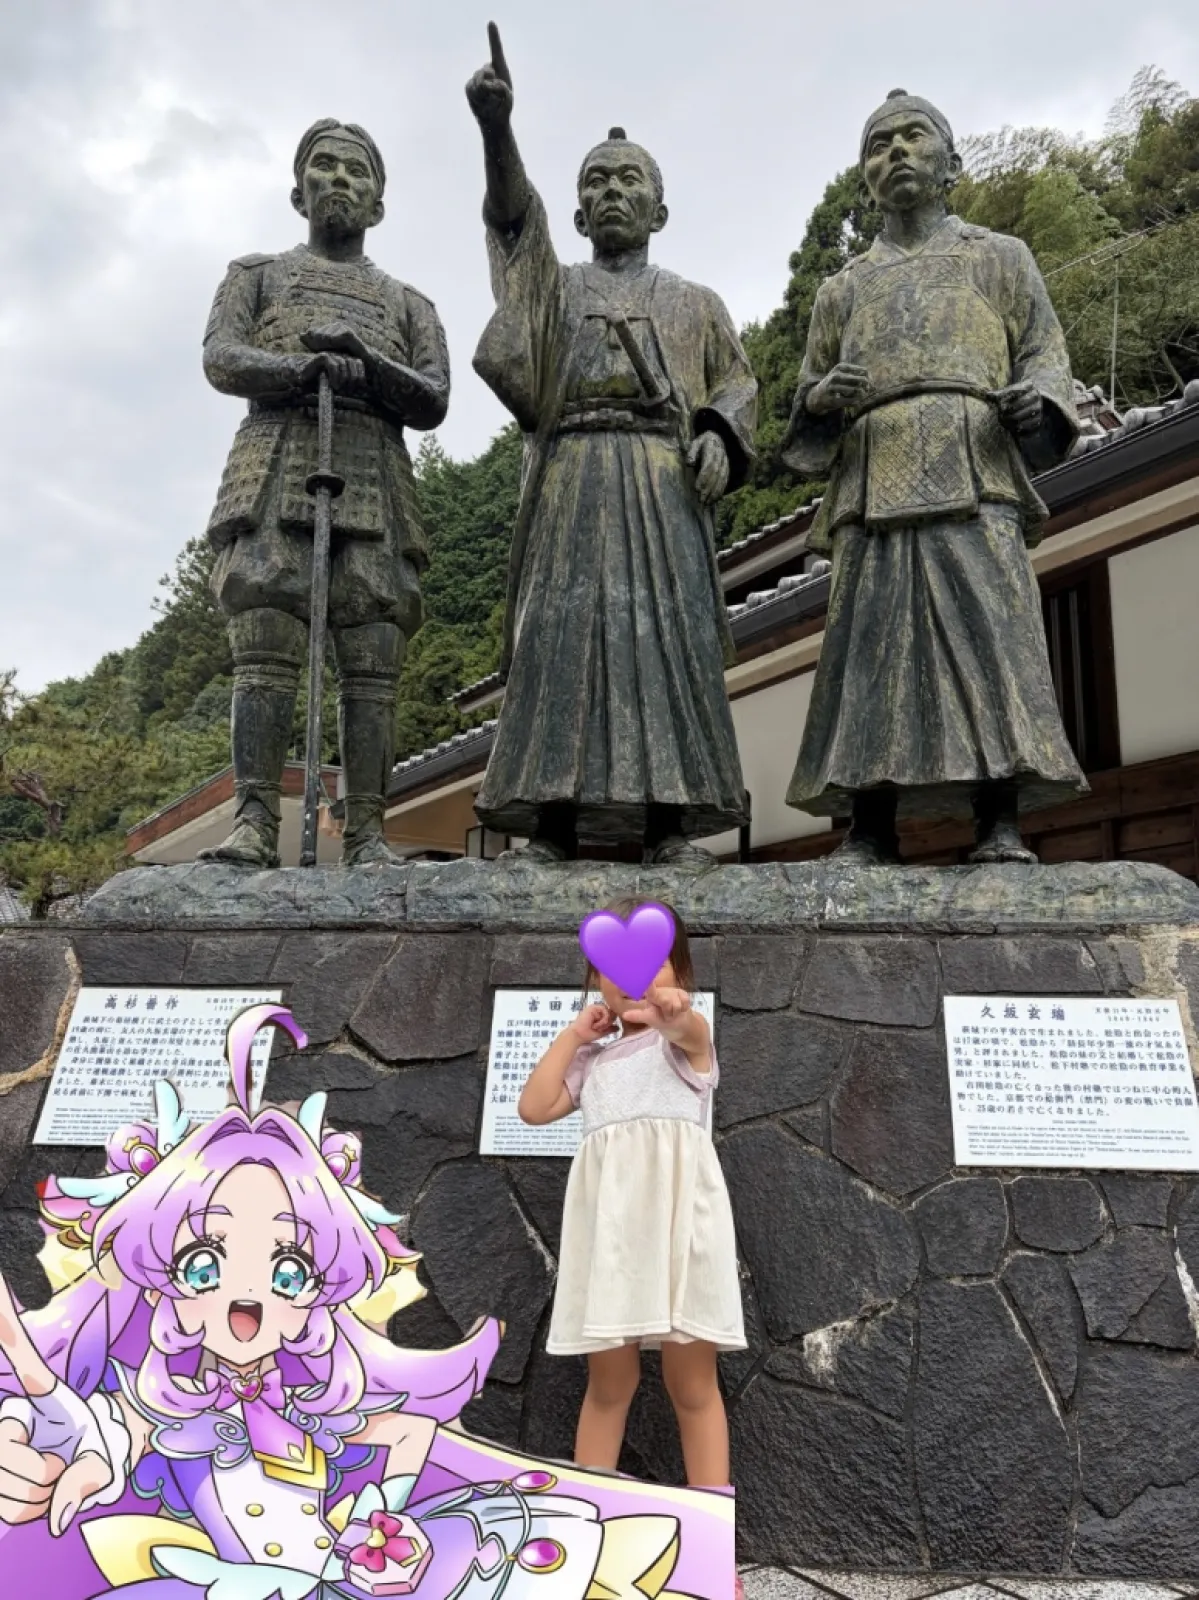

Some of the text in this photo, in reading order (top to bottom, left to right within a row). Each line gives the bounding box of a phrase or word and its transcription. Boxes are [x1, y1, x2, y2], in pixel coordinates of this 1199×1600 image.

[528, 999, 604, 1012] 吉田松
[980, 1005, 1066, 1021] 久坂玄瑞
